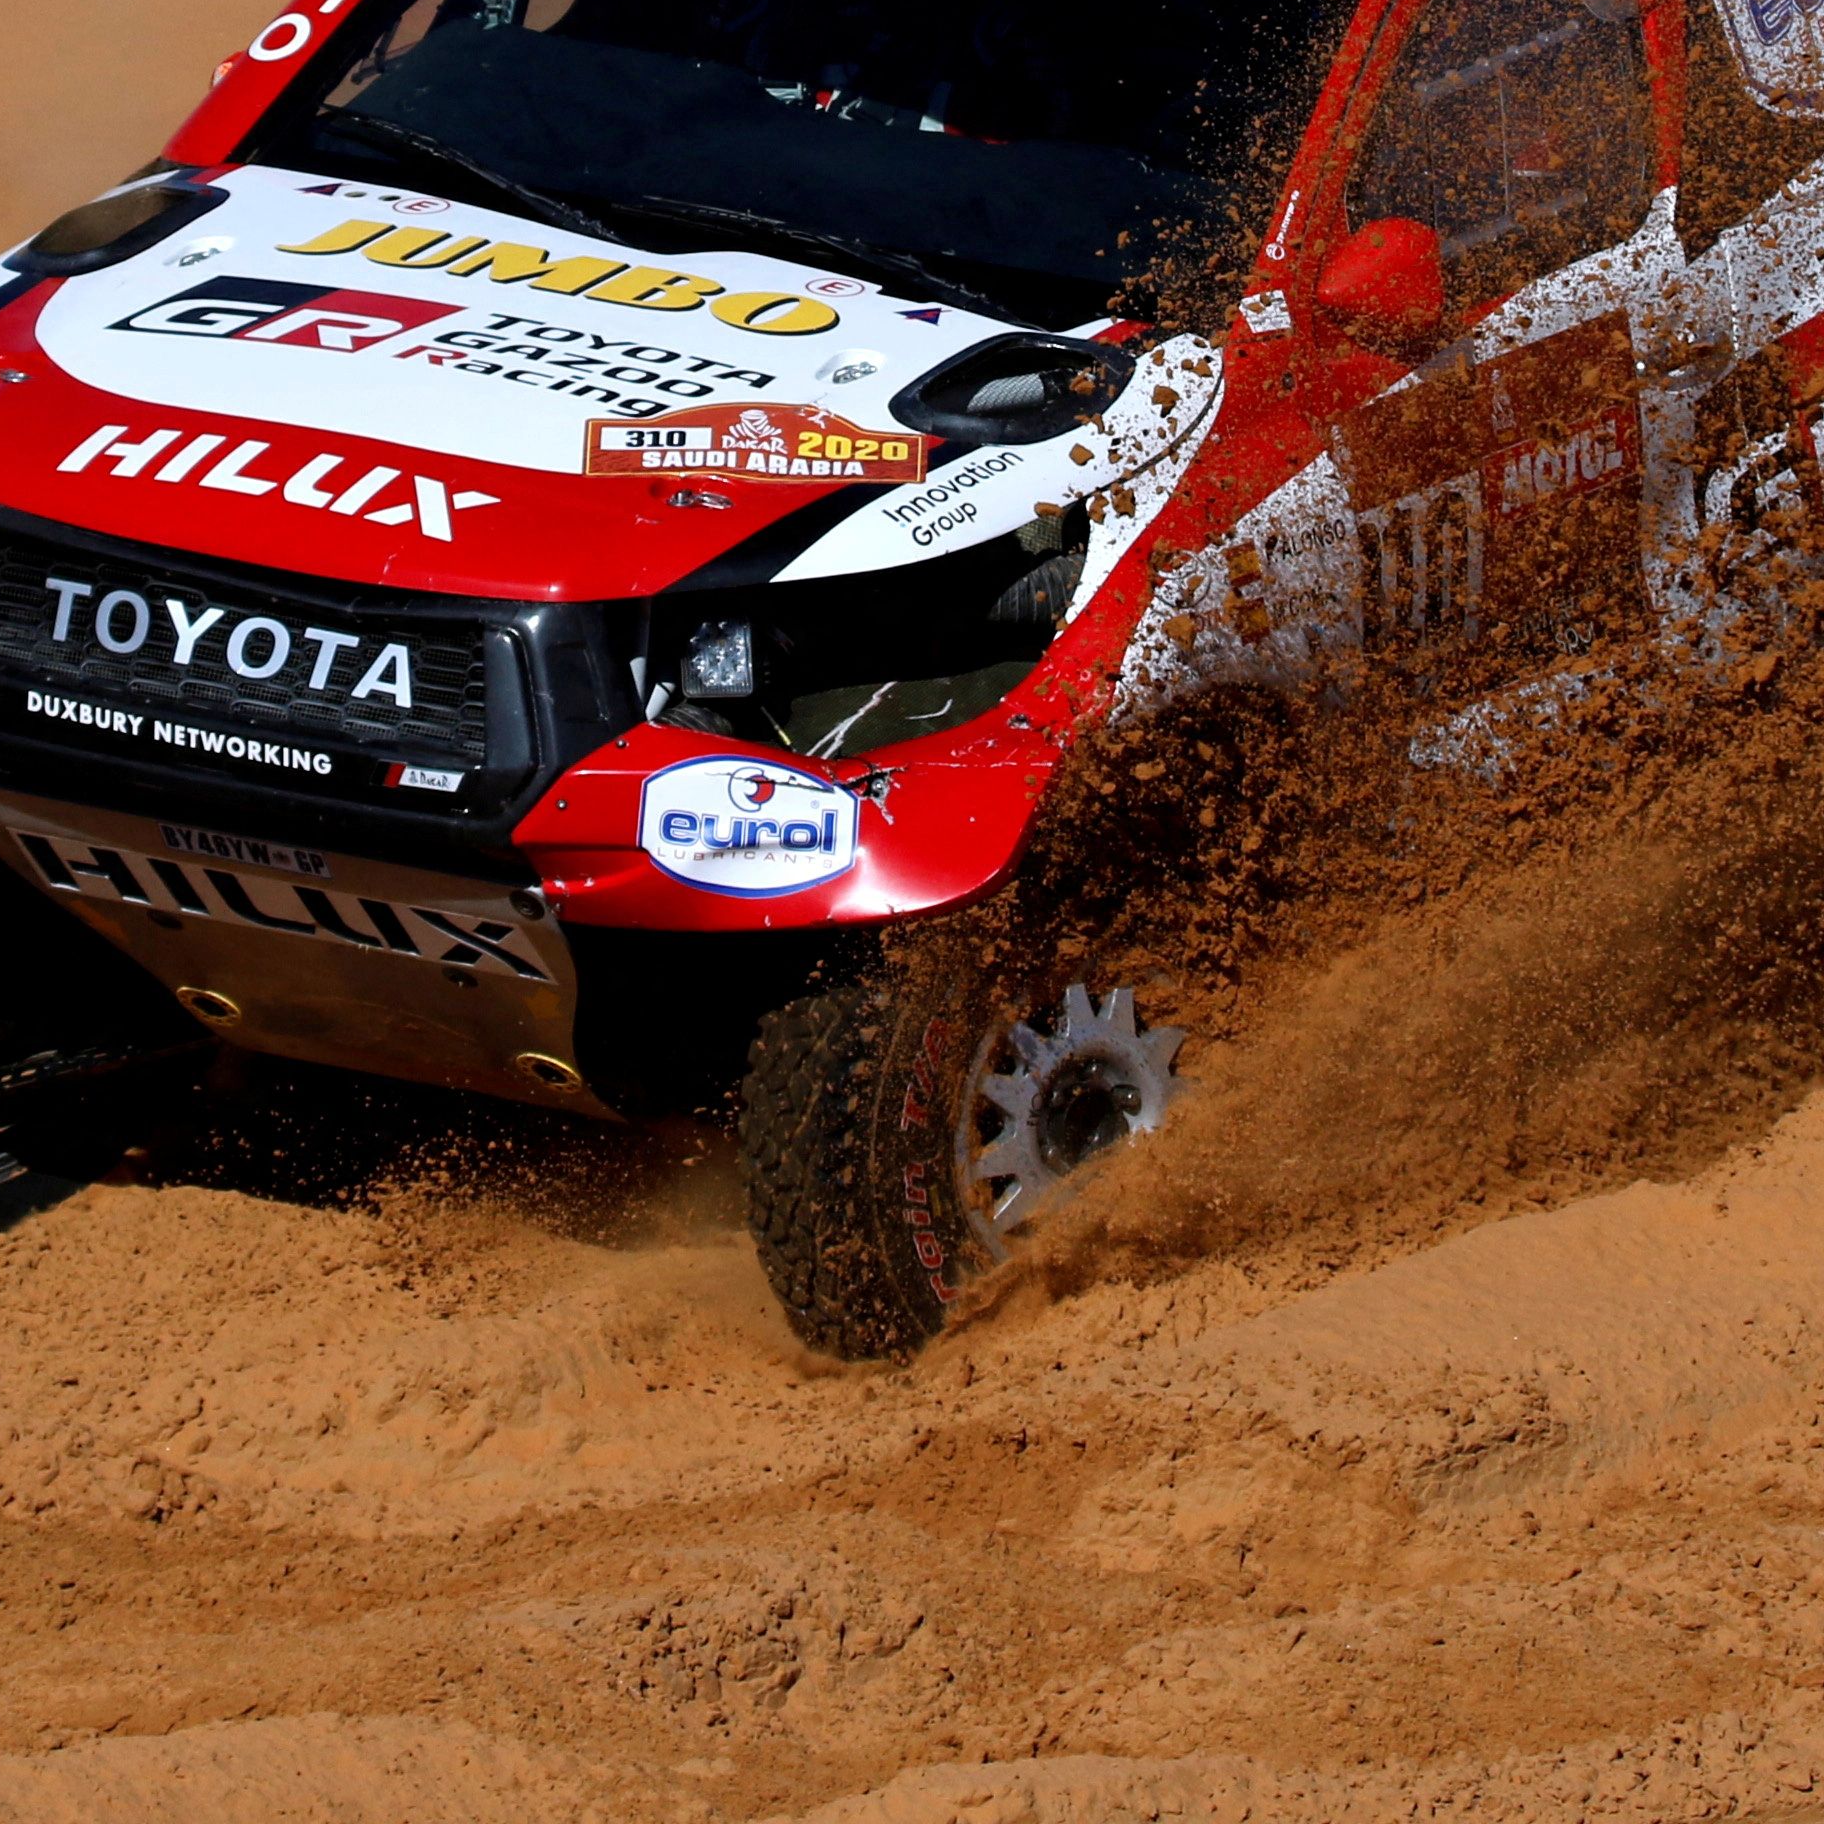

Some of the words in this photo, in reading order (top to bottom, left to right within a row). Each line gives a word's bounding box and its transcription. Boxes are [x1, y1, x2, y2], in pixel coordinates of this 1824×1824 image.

[275, 218, 840, 336] JUMBO
[128, 299, 404, 351] GR
[484, 312, 778, 389] TOYOTA
[393, 345, 674, 418] Racing
[433, 331, 715, 398] GAZOO
[625, 429, 687, 448] 310
[641, 450, 737, 468] SAUDI
[745, 454, 865, 476] ARABIA
[721, 434, 789, 455] DAKAR
[797, 431, 909, 461] 2020
[56, 425, 502, 542] HILUX
[881, 451, 1024, 522] Innovation
[912, 502, 977, 546] Group
[1282, 519, 1346, 560] ALONSO
[45, 577, 412, 709] TOYOTA
[26, 689, 144, 736] DUXBURY
[154, 720, 332, 776] NETWORKING
[659, 808, 839, 855] eurol
[293, 850, 326, 875] GP
[657, 848, 832, 869] LUBRICANTS
[17, 832, 555, 983] HILUX
